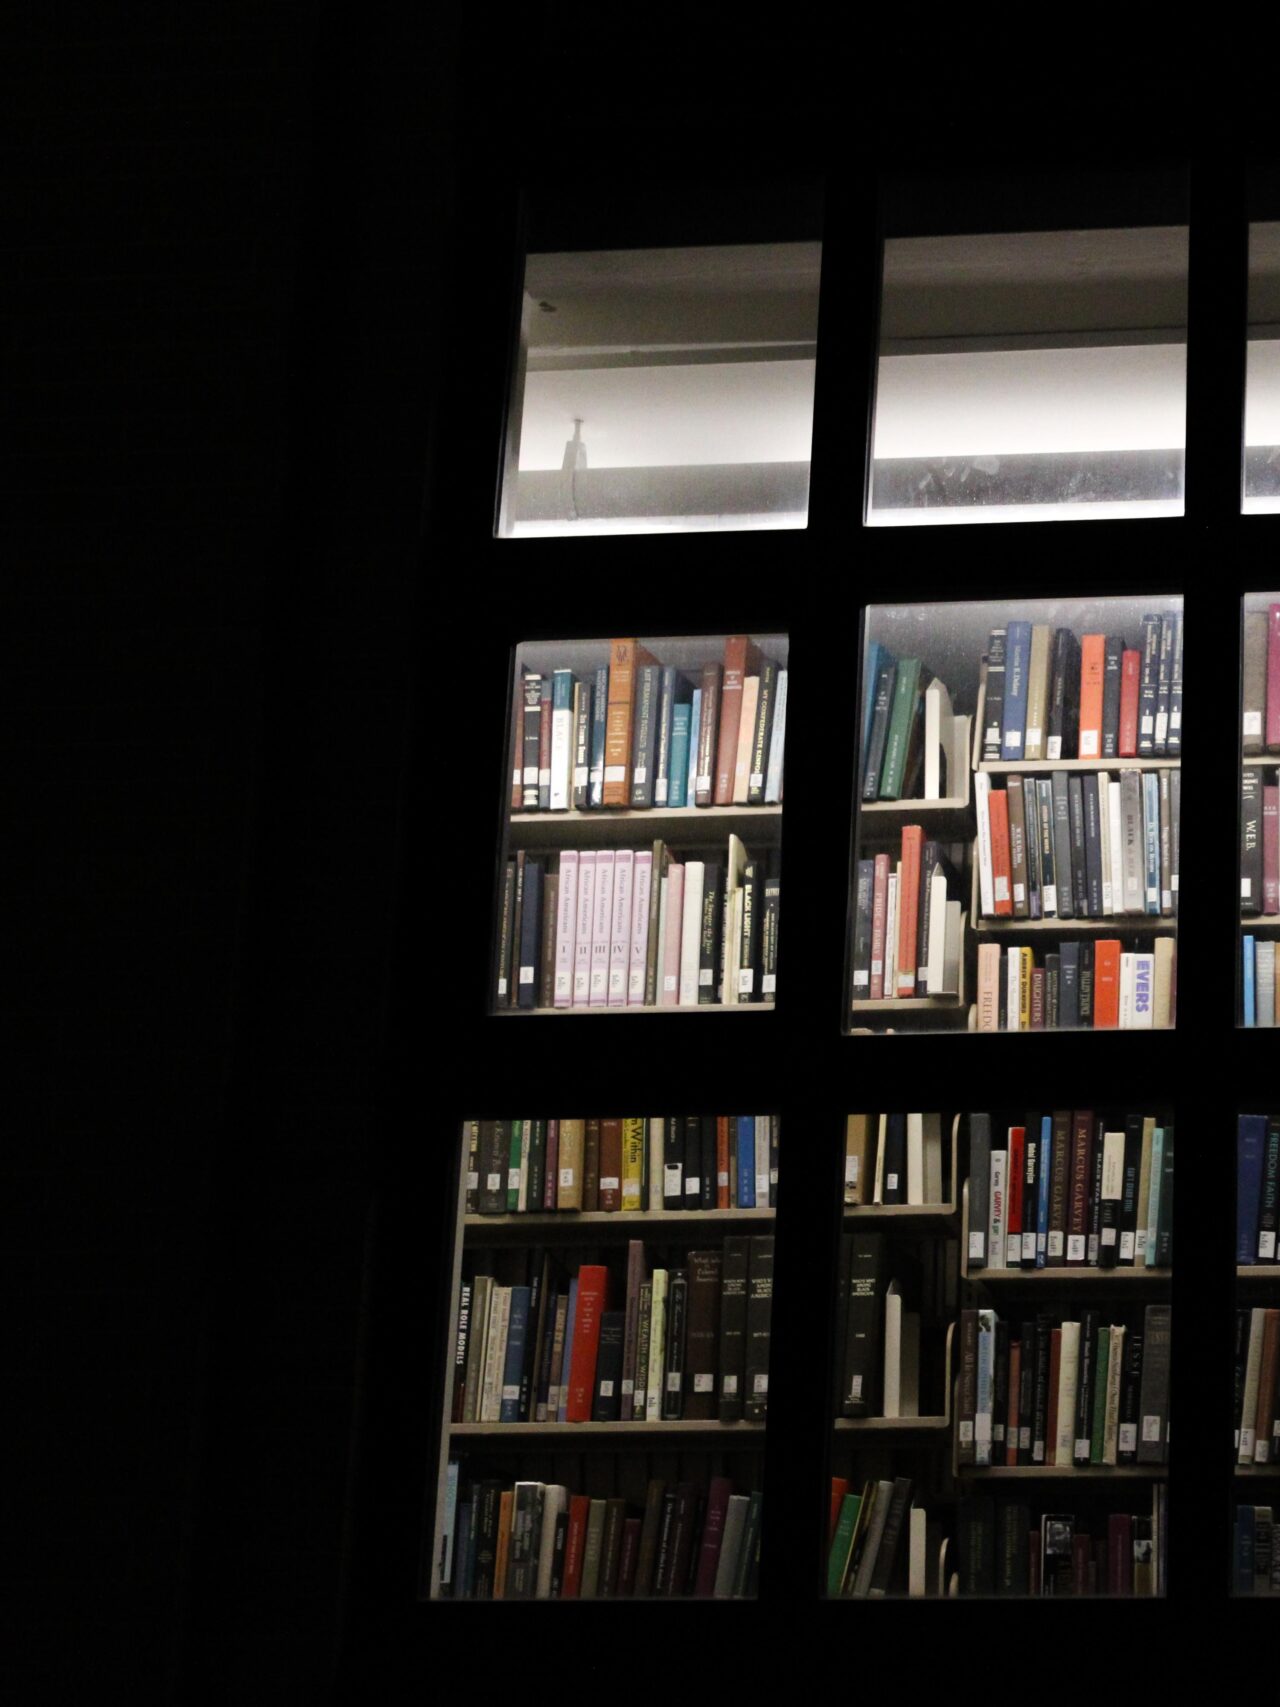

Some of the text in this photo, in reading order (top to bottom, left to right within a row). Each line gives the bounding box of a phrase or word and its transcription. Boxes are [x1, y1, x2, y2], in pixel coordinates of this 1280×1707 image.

[757, 702, 768, 748] CONFEDERATE
[1245, 820, 1257, 851] W.E.B.
[562, 869, 572, 933] African Americans
[580, 870, 591, 934] African Americans
[598, 869, 608, 933] African Americans
[616, 869, 627, 933] African Americans
[636, 870, 646, 934] African Americans
[743, 885, 753, 937] BLACK LIGHT
[874, 893, 883, 918] PRIDE
[873, 929, 882, 955] FAMILY
[1033, 974, 1042, 1022] DAUGHTERS
[1135, 960, 1151, 1013] EVERS
[630, 1126, 643, 1163] Within
[1055, 1130, 1066, 1183] MARCUS
[1265, 1132, 1280, 1208] FREEDOM FAITH
[993, 1191, 1002, 1217] GARVEY
[1072, 1128, 1087, 1232] MARCUS GARVEY
[456, 1286, 471, 1365] REAL ROLE MODELS
[640, 1319, 650, 1353] WEALTH
